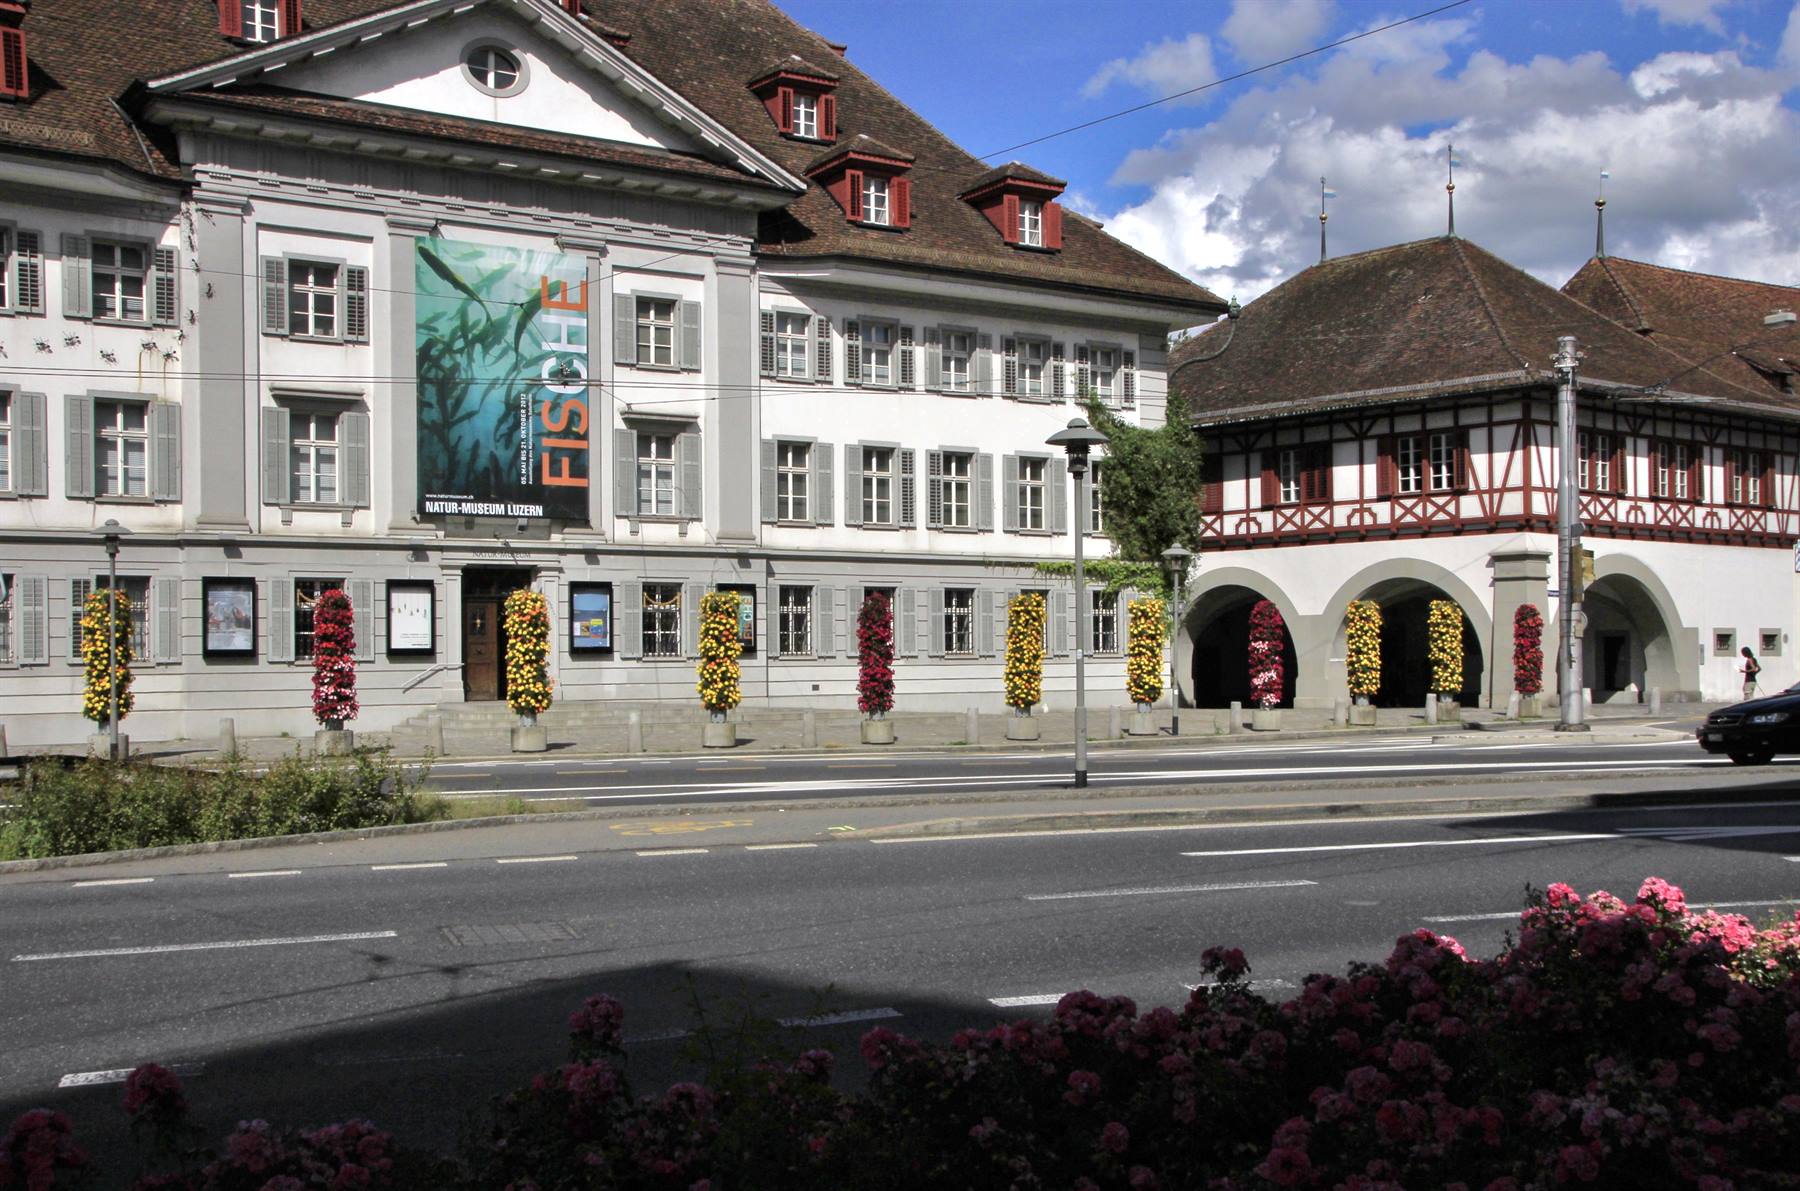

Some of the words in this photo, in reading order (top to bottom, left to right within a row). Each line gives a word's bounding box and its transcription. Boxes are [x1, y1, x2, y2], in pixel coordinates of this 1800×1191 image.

[541, 276, 589, 487] FISCHE
[425, 501, 505, 515] NATUR-MUSEUM
[507, 504, 543, 516] LUZERN
